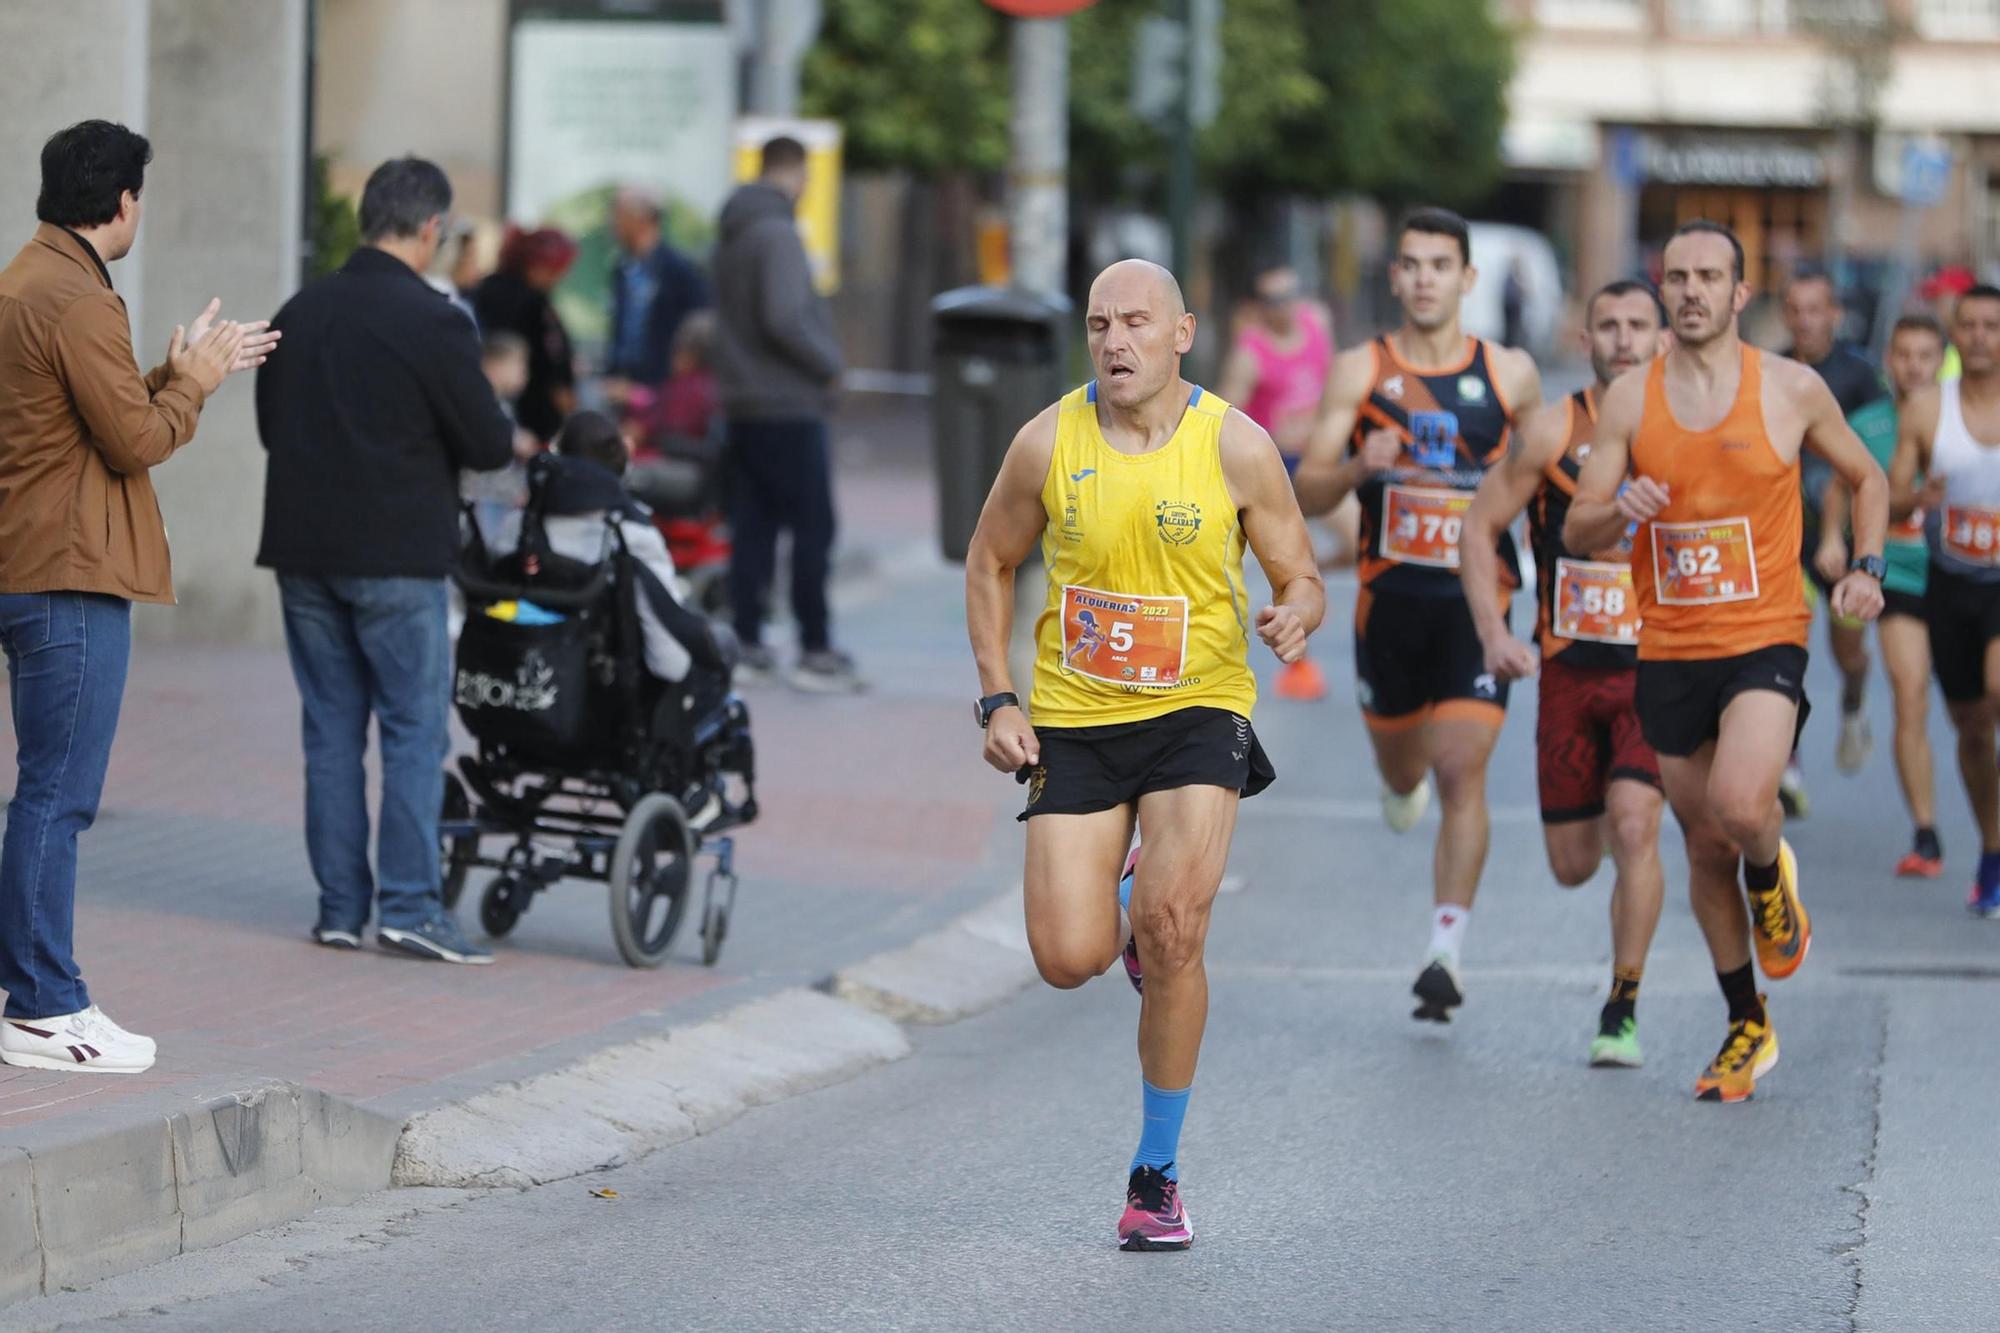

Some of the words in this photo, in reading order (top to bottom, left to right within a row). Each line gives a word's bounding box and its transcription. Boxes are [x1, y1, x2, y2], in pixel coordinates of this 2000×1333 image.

[1678, 544, 1722, 577] 62
[1075, 595, 1137, 613] ALQUERIAS
[1142, 606, 1169, 616] 2023
[1583, 586, 1625, 616] 58
[1108, 621, 1134, 652] 5
[1111, 655, 1128, 663] ARCE
